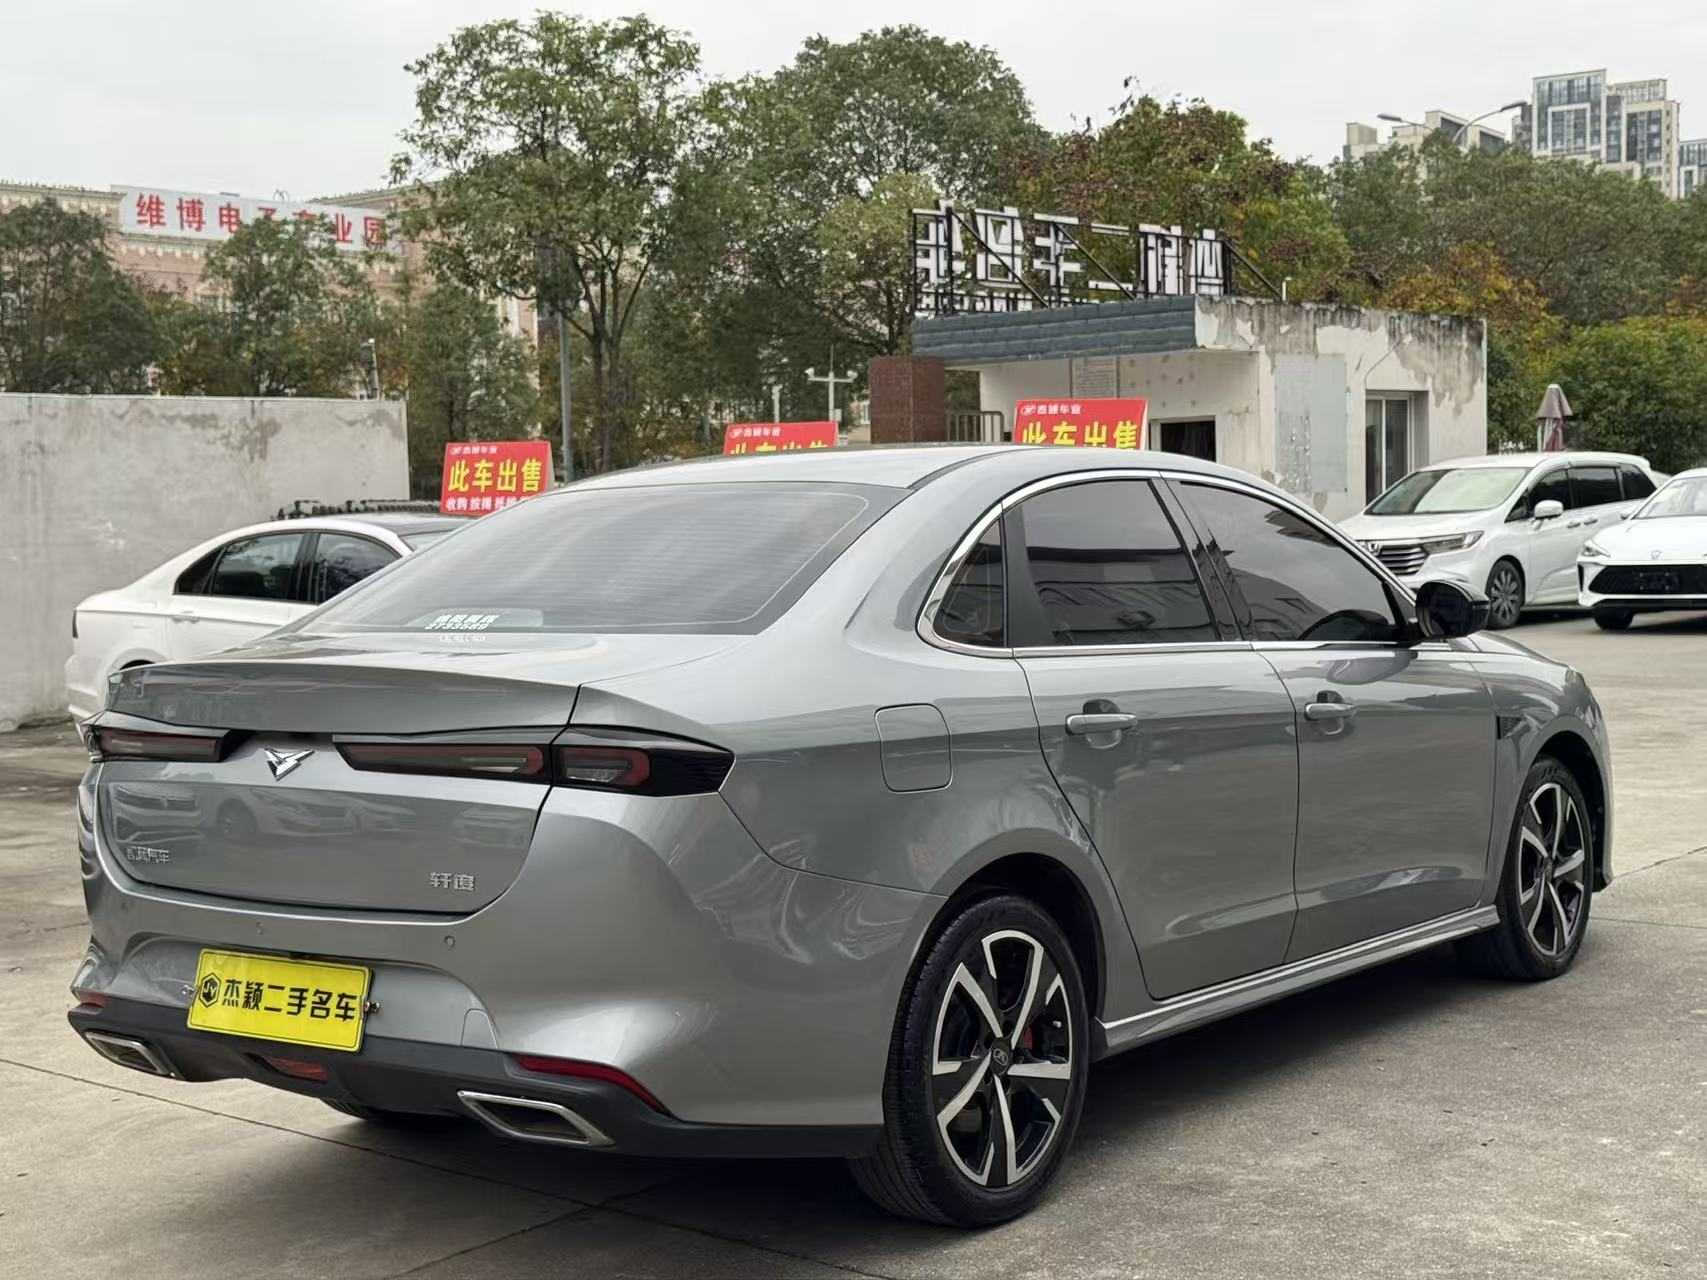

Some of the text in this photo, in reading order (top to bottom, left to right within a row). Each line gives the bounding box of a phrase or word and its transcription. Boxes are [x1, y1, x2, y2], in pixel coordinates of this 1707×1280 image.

[447, 458, 543, 493] 此车出售
[430, 871, 475, 891] 轩度
[222, 978, 358, 1022] 杰颖二手名车
